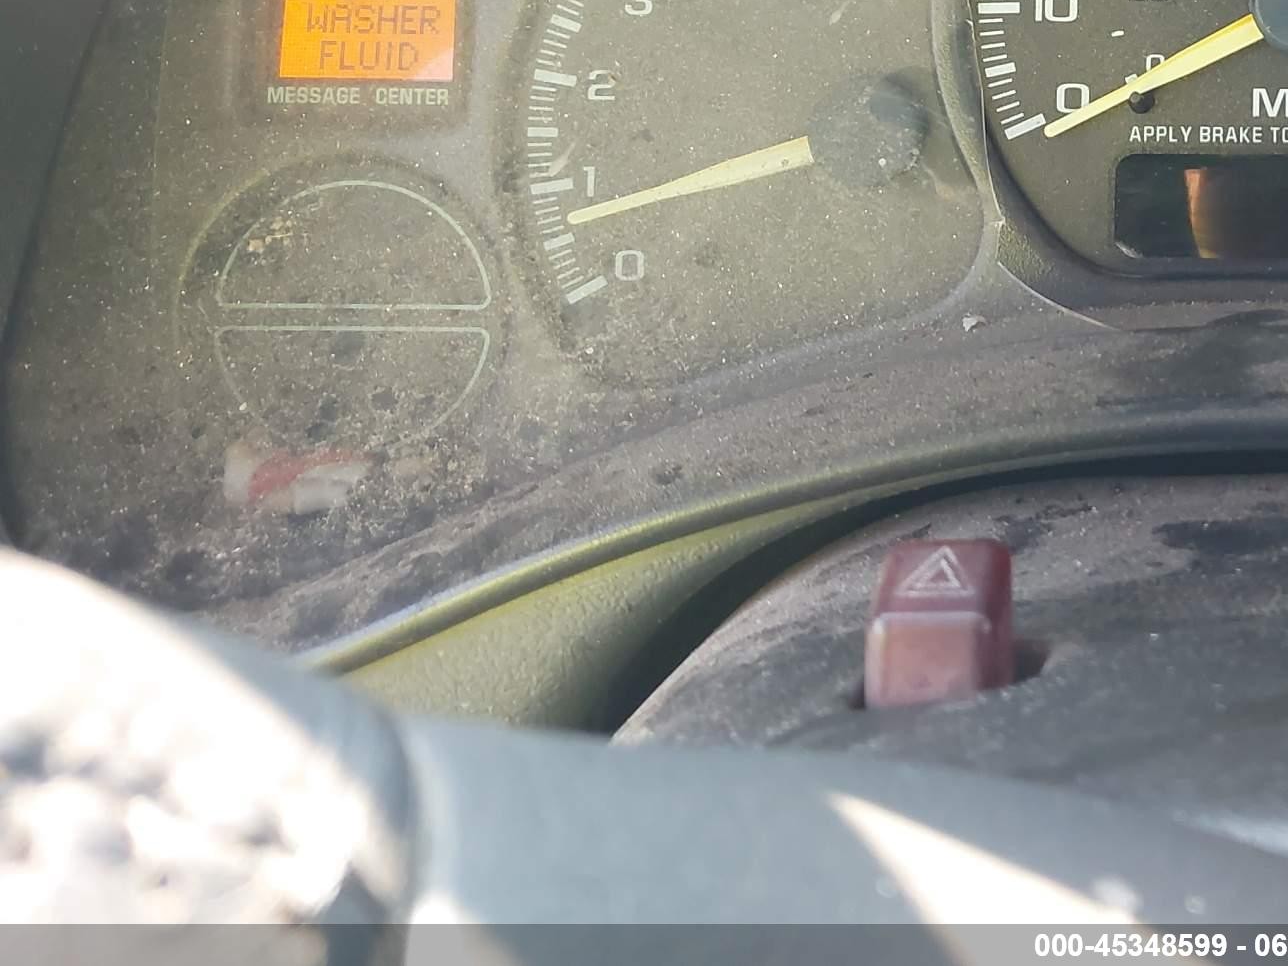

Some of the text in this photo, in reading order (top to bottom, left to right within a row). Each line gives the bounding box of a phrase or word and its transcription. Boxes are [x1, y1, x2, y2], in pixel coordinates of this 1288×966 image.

[307, 5, 440, 34] WASHER
[319, 40, 418, 70] FLUID
[267, 87, 449, 105] MESSAGE CENTER
[588, 70, 615, 100] 2
[1056, 83, 1090, 113] 0
[1130, 126, 1191, 142] APPLY
[1200, 126, 1262, 143] BRAKE
[583, 165, 598, 197] 1
[615, 250, 645, 280] 0
